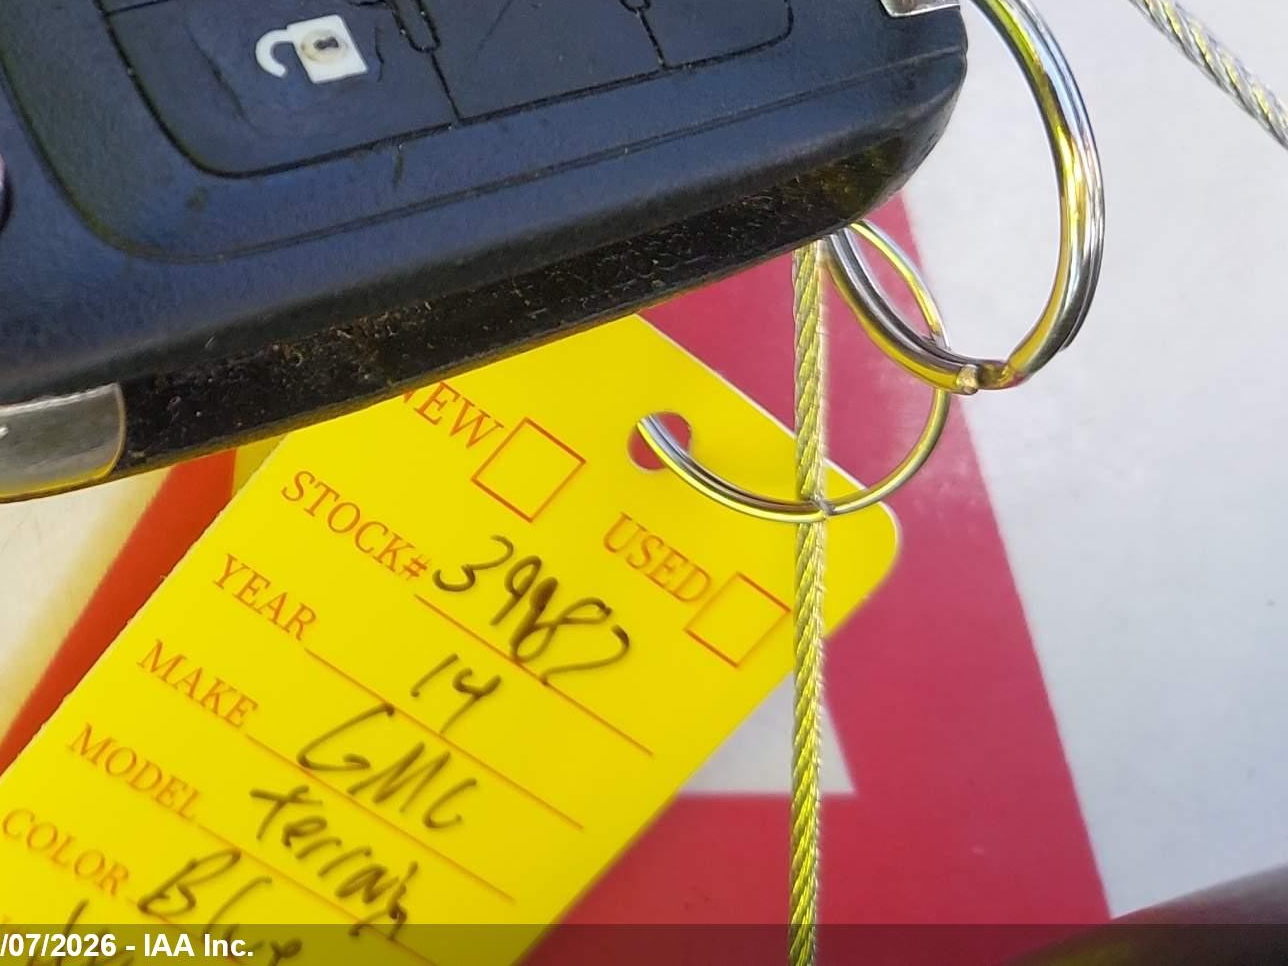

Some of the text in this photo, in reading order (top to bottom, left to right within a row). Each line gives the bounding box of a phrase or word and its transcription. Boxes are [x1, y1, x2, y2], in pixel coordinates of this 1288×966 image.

[403, 381, 505, 449] EW
[281, 470, 432, 581] STOCK#
[602, 512, 713, 605] USED
[213, 553, 317, 640] YEAR
[136, 640, 258, 729] MAKE
[410, 652, 502, 734] 14
[66, 722, 201, 822] MODEL
[297, 703, 478, 830] GMC
[1, 808, 130, 897] COLOR
